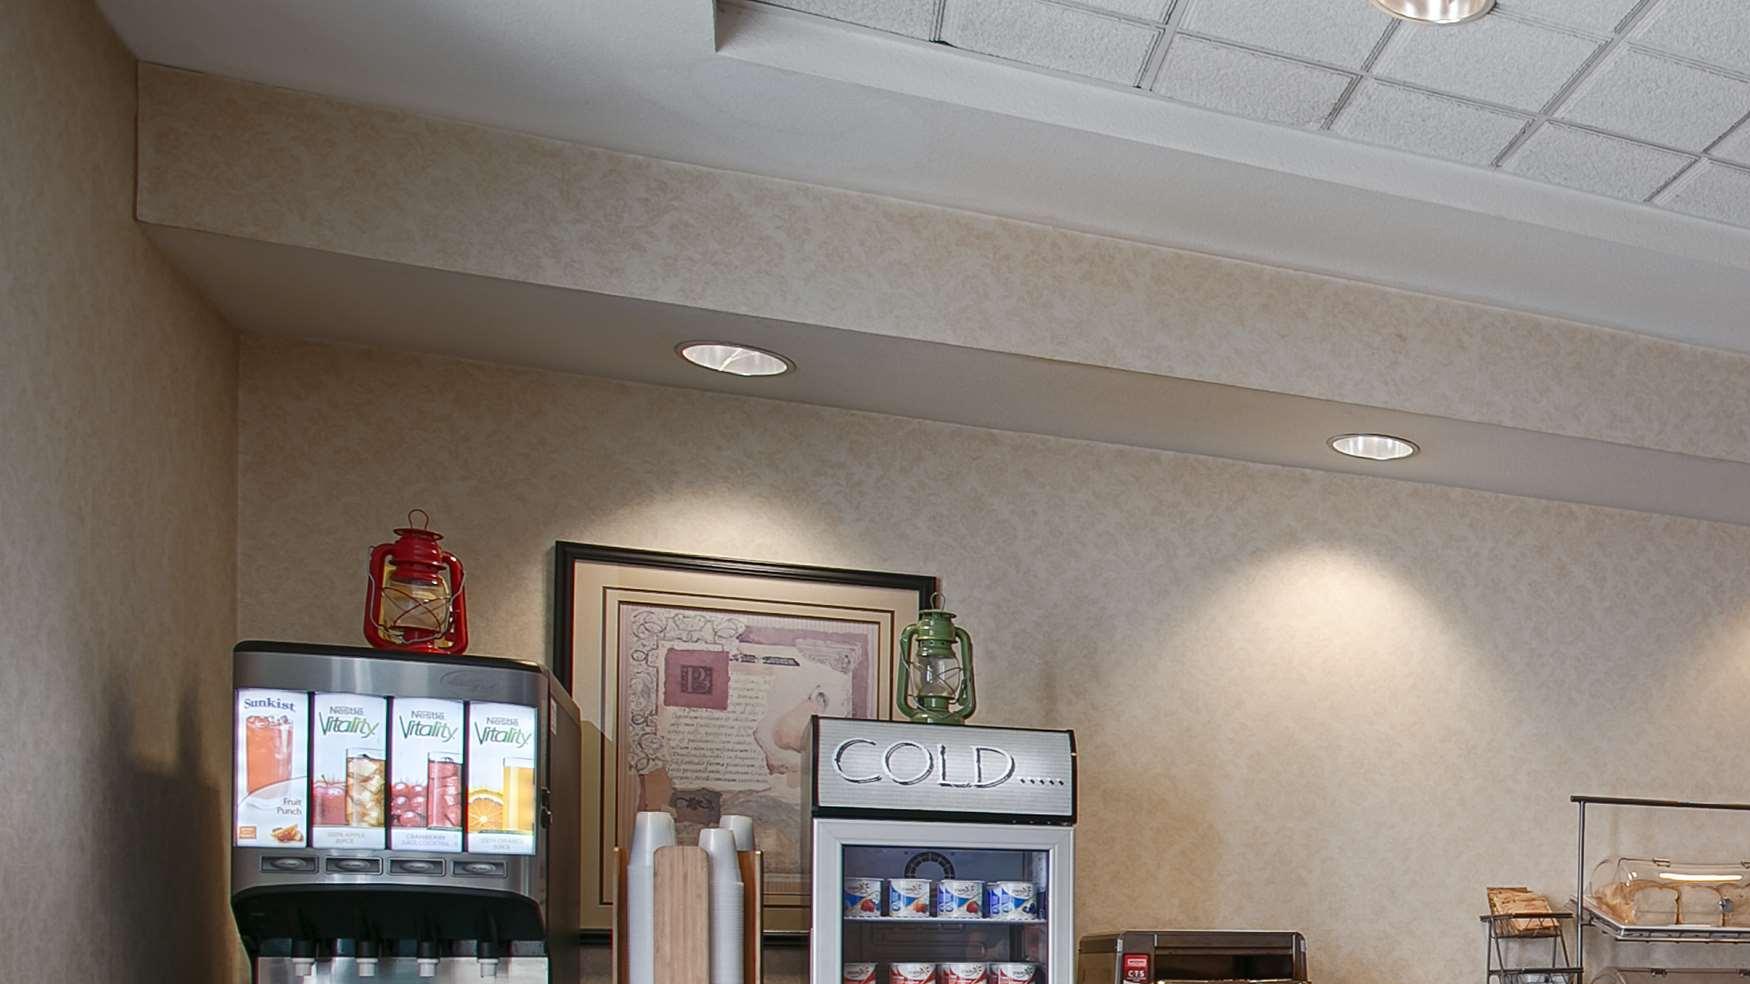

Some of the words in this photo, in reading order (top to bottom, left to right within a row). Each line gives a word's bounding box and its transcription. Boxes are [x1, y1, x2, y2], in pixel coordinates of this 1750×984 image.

[243, 696, 296, 713] Sunkist
[319, 711, 380, 739] Vitality
[399, 714, 458, 743] Vitality
[474, 721, 532, 749] Vitality
[276, 806, 303, 816] Punch
[282, 797, 302, 806] Fruit
